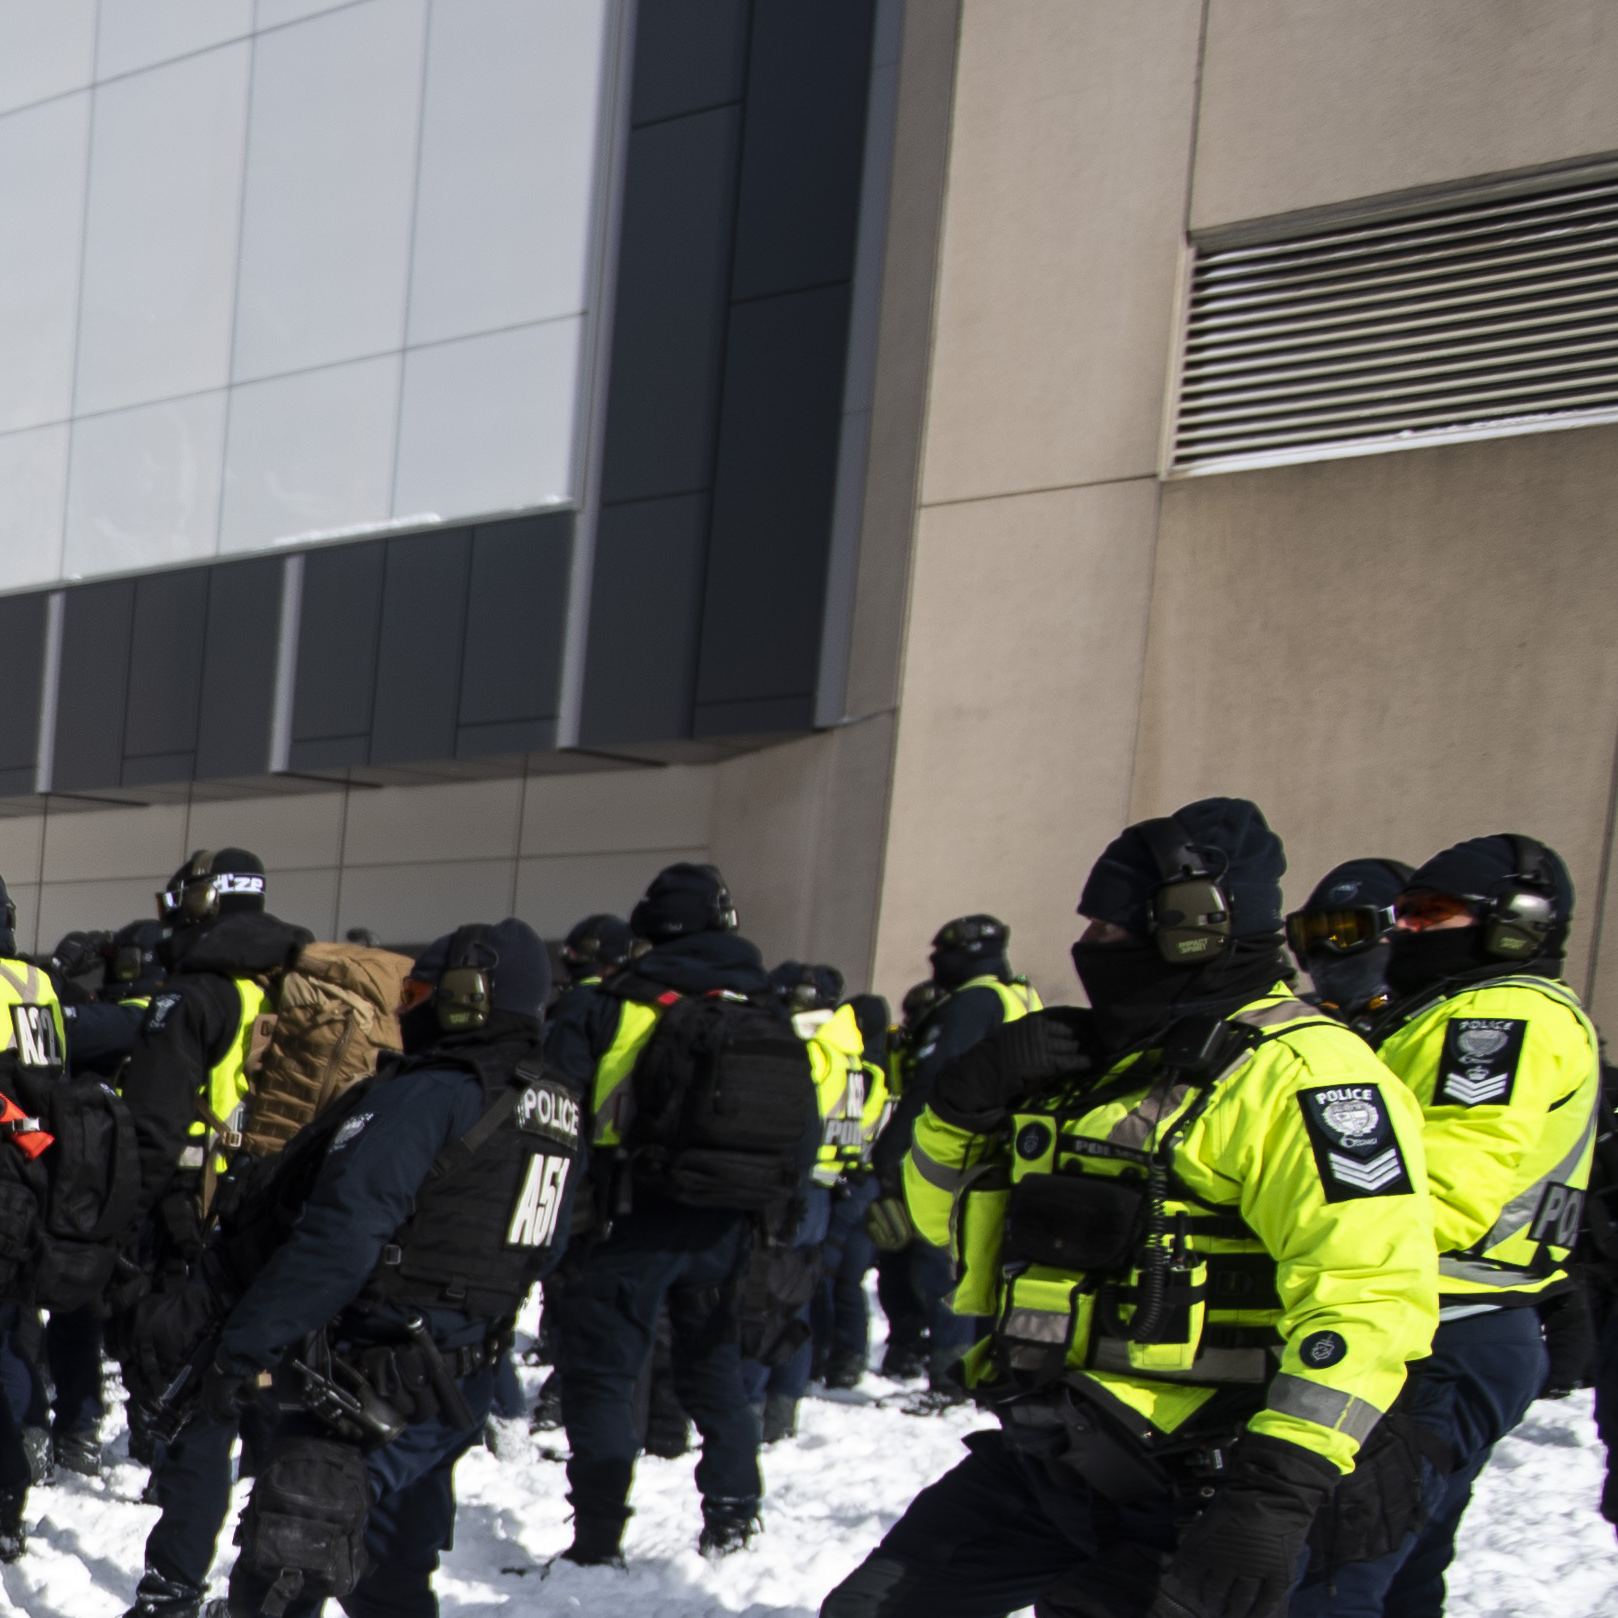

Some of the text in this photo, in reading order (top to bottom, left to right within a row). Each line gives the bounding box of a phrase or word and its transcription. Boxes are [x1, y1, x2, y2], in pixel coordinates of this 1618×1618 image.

[523, 1088, 579, 1136] POLICE
[1315, 1088, 1372, 1105] POLICE
[508, 1153, 570, 1247] A51
